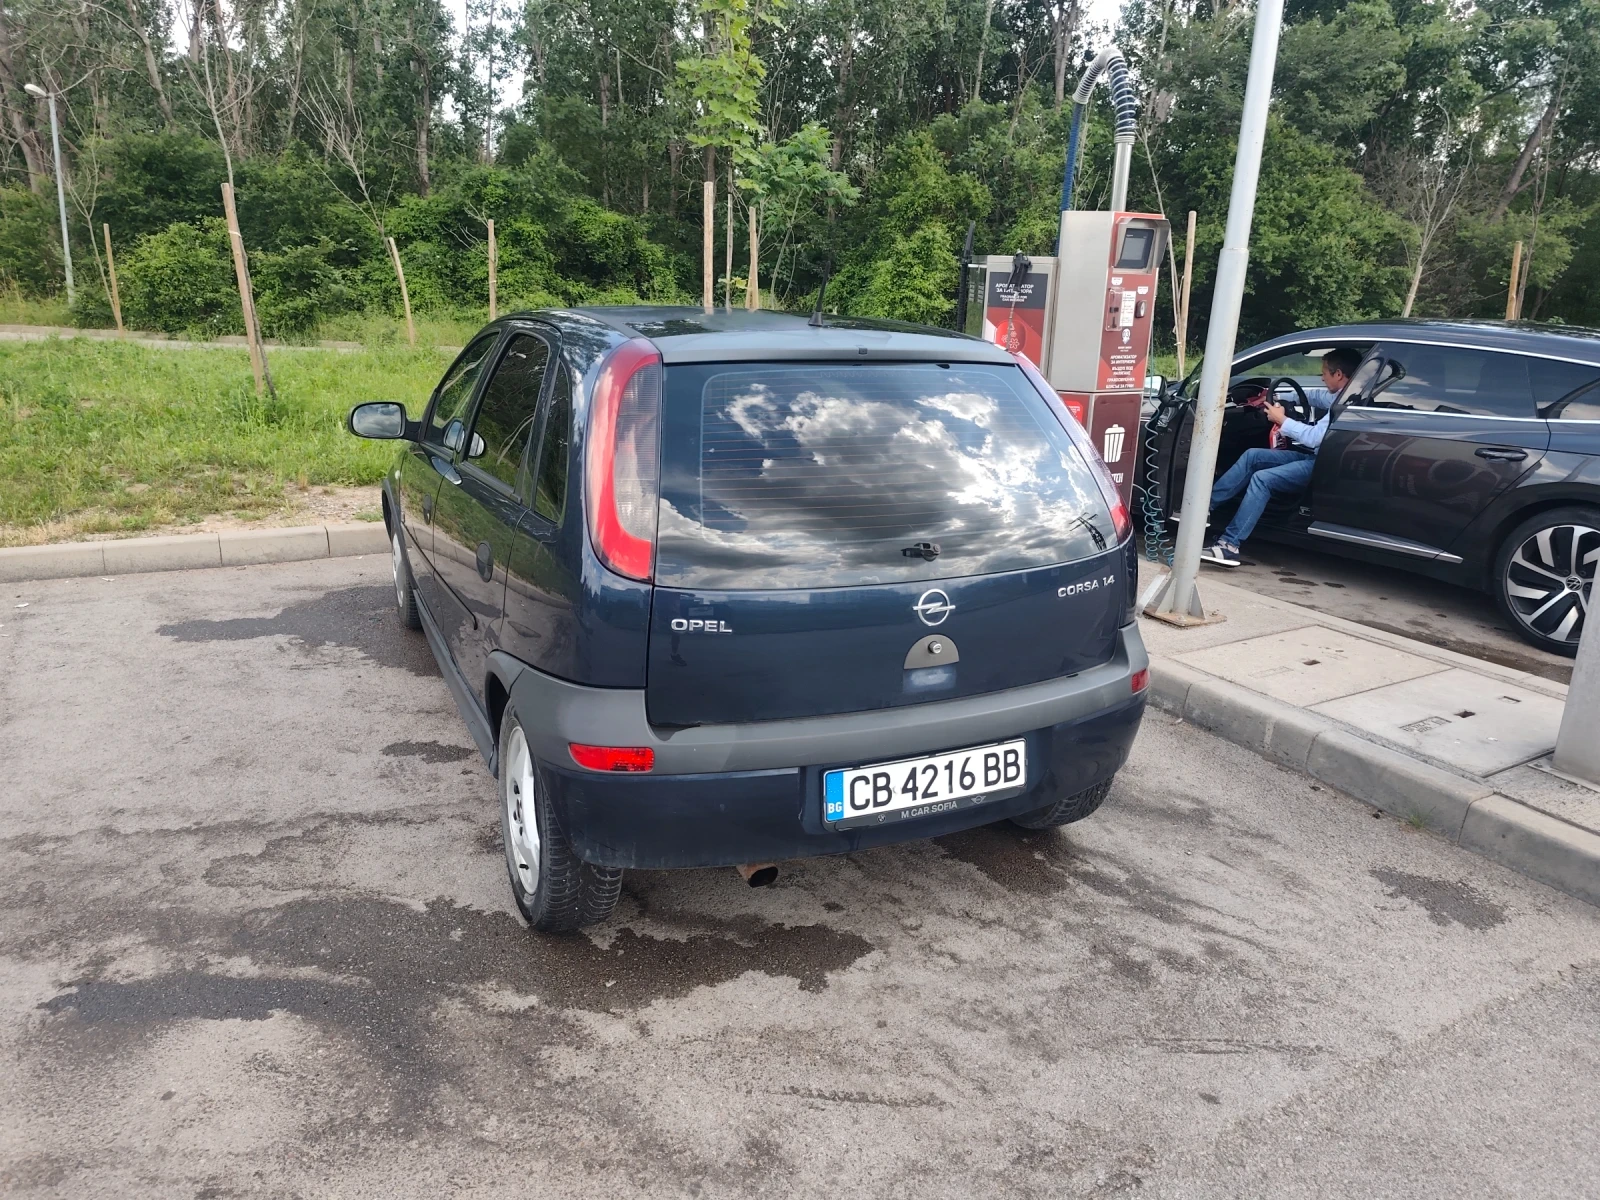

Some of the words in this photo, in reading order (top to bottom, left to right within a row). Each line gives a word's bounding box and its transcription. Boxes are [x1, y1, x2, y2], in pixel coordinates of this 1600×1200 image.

[1057, 579, 1099, 598] CORSA
[671, 618, 733, 633] OPEL
[849, 771, 893, 811] CB
[901, 756, 976, 801] 4216
[983, 748, 1021, 787] BB
[828, 801, 842, 814] BG
[901, 810, 909, 819] M
[911, 806, 930, 818] CAR
[931, 800, 958, 814] SOFIA
